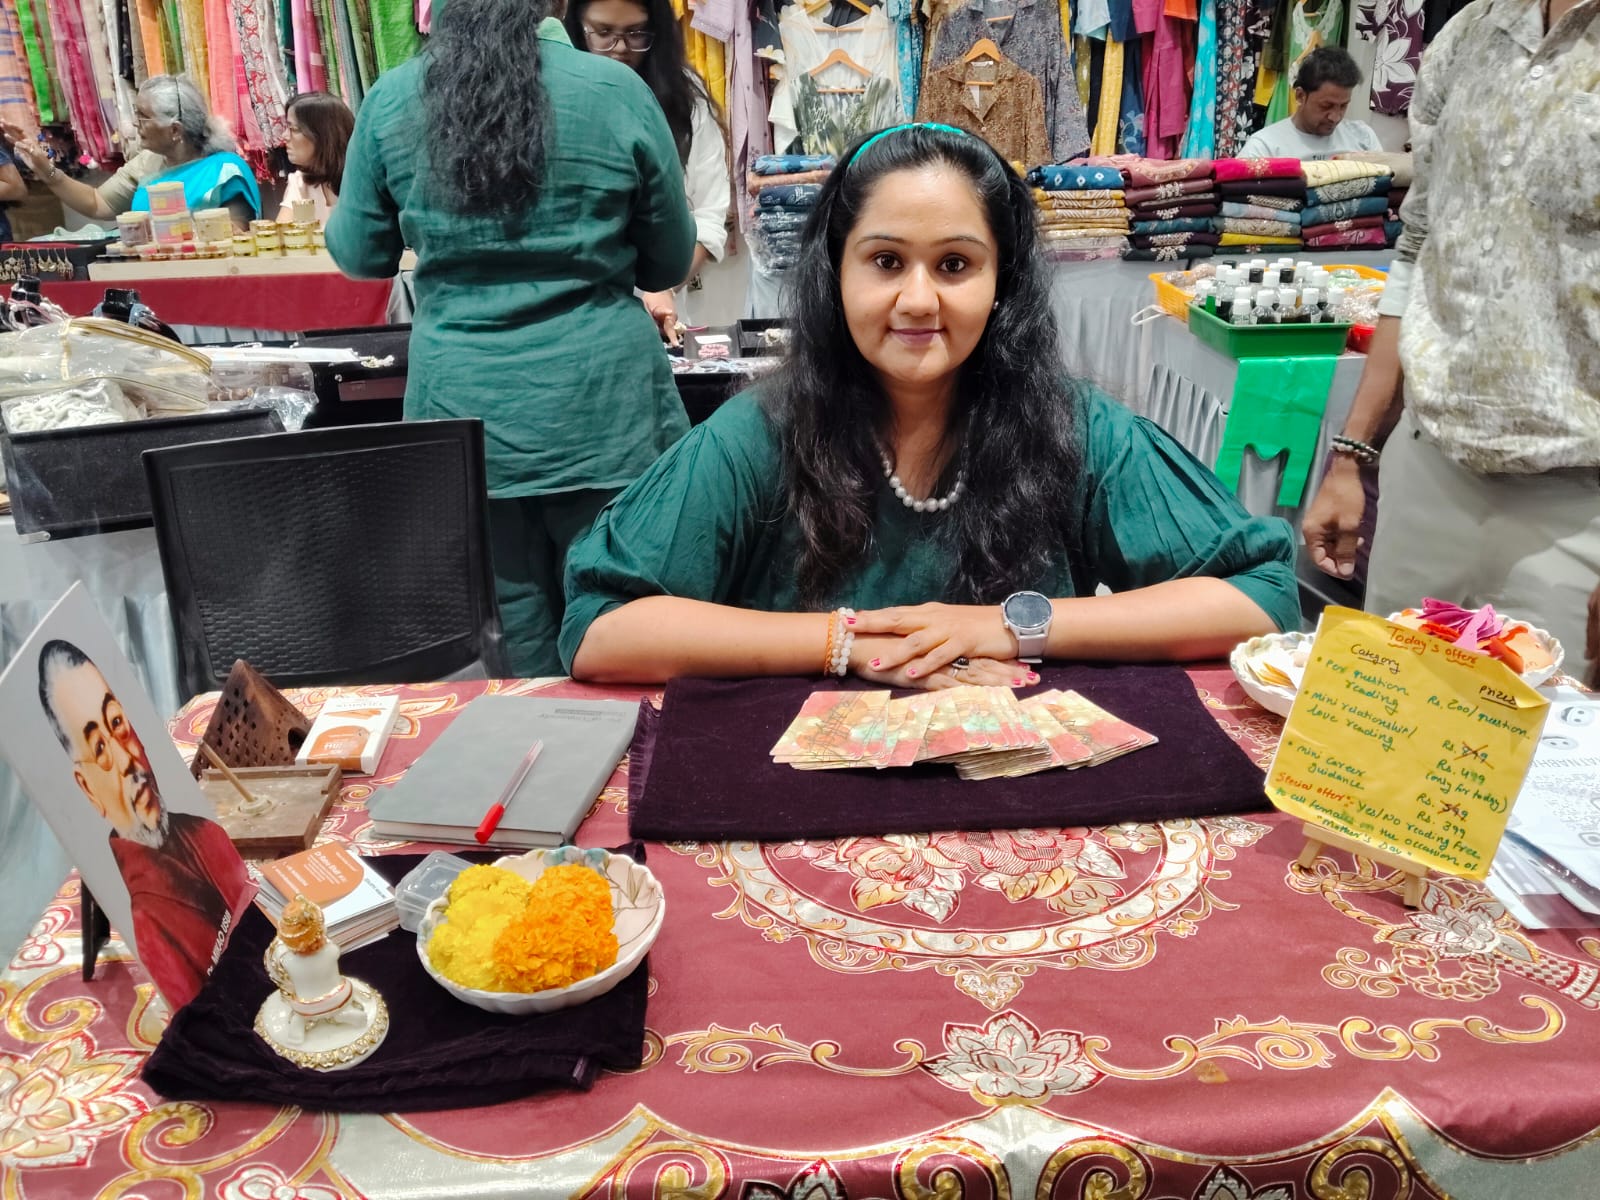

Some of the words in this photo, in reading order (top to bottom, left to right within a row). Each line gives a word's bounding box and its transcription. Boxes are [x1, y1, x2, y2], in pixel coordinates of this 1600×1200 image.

[1386, 625, 1439, 656] Today's
[1351, 643, 1400, 674] Category
[1346, 680, 1399, 716] reading
[1346, 719, 1396, 752] reading
[1308, 762, 1365, 791] guidance
[1461, 767, 1486, 786] 499
[1406, 822, 1450, 851] reading
[1442, 820, 1466, 839] 399
